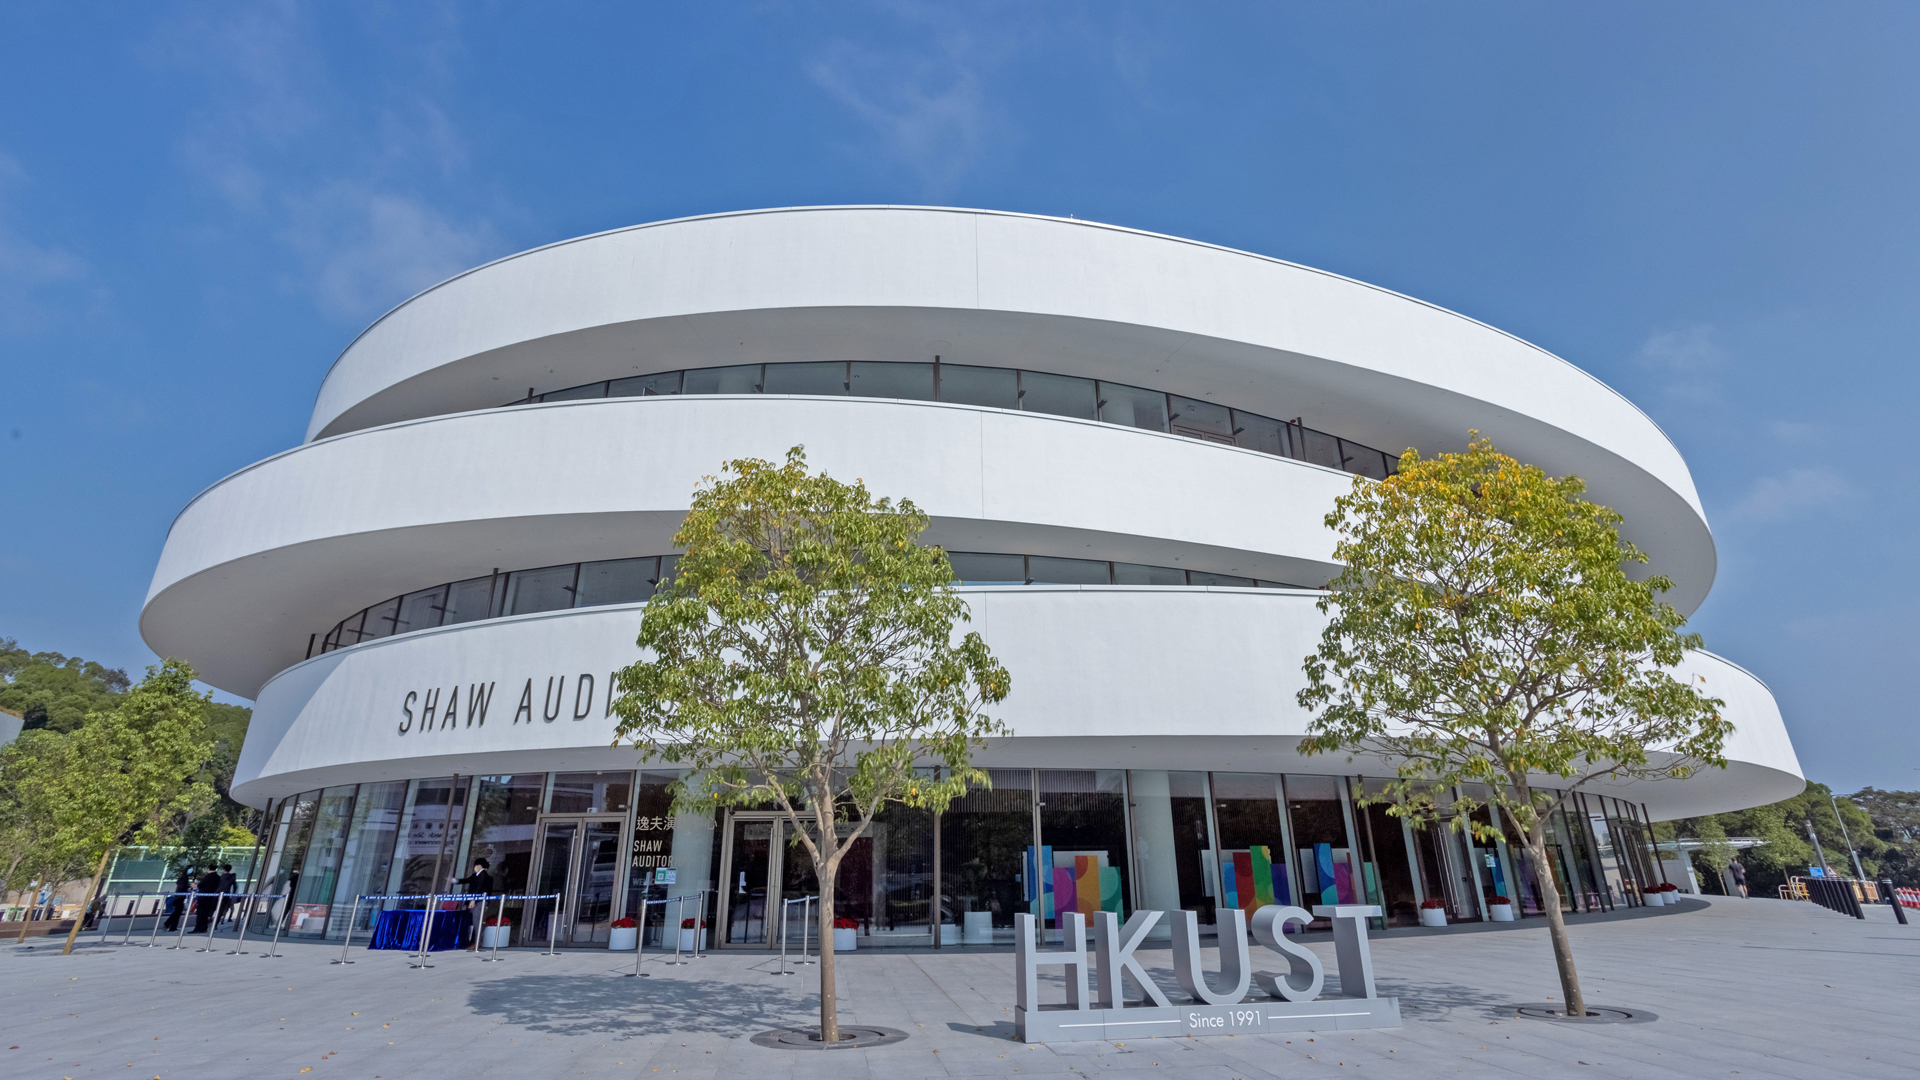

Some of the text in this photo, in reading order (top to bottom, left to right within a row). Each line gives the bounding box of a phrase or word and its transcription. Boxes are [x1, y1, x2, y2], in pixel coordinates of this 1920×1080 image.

[398, 681, 495, 734] SHAW
[633, 839, 663, 852] SHAW
[1015, 904, 1382, 1012] HKUST
[1188, 1010, 1262, 1029] Since 1991
